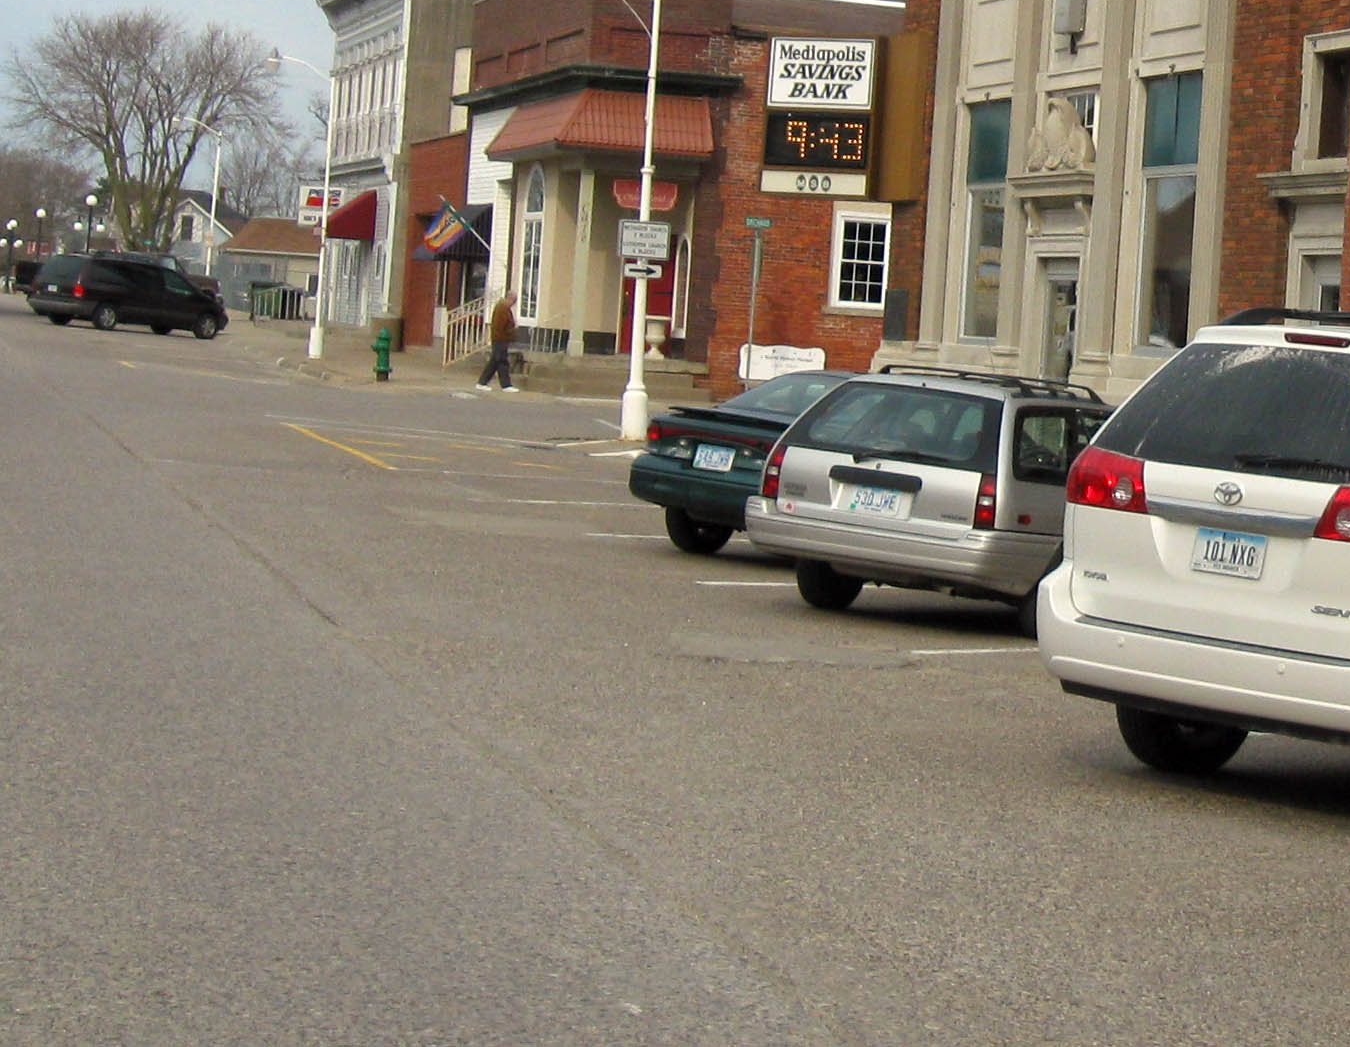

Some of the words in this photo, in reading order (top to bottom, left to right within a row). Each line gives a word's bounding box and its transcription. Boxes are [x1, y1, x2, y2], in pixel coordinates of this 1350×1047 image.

[779, 44, 866, 63] Mediapolis
[779, 63, 867, 81] SAVINGS
[788, 82, 853, 100] BANK
[787, 121, 864, 160] 9:43
[1203, 539, 1228, 563] 101
[1228, 543, 1257, 567] NXG
